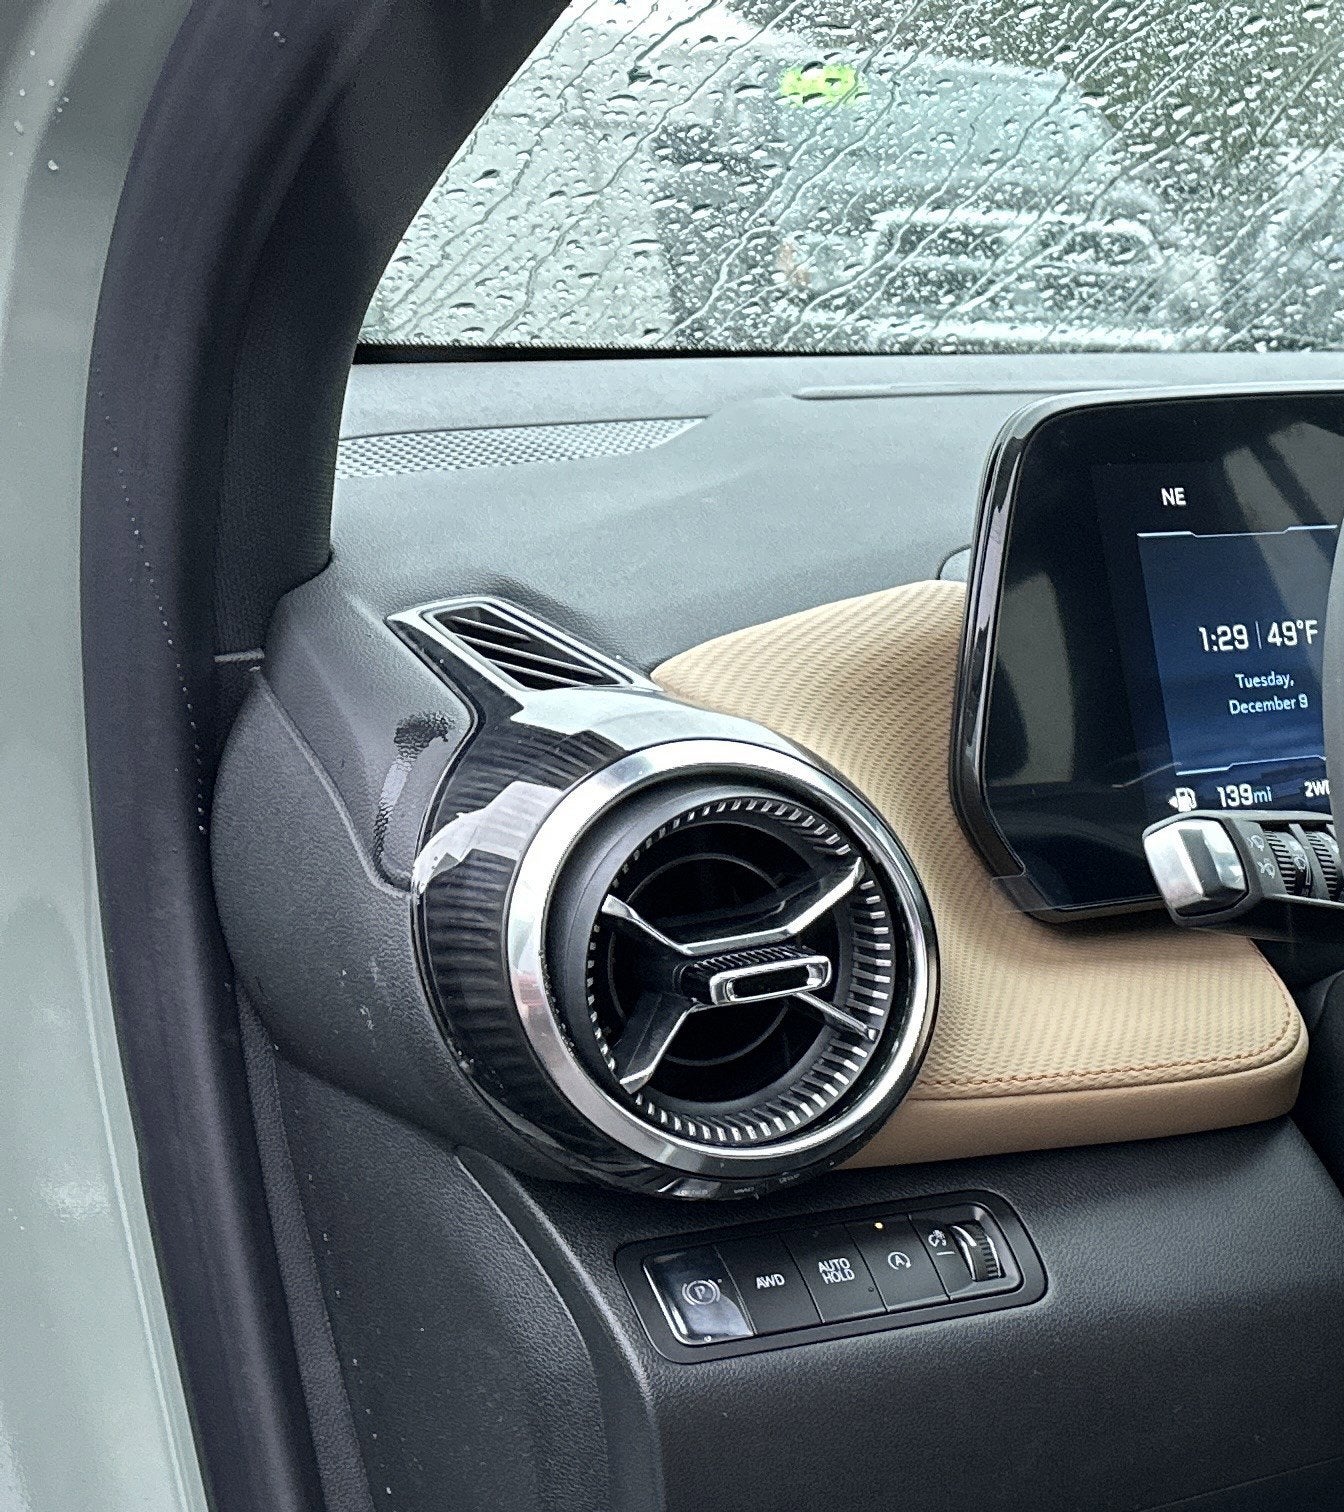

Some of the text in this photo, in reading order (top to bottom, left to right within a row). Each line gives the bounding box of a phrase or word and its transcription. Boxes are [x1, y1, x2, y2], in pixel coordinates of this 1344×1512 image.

[1160, 487, 1187, 506] NE
[1198, 619, 1319, 652] 1:29 49°F
[1234, 670, 1295, 689] Tuesday,
[1228, 692, 1309, 715] December 9
[817, 1257, 851, 1274] AUTO
[755, 1273, 786, 1290] AWD
[821, 1268, 855, 1285] HOLD
